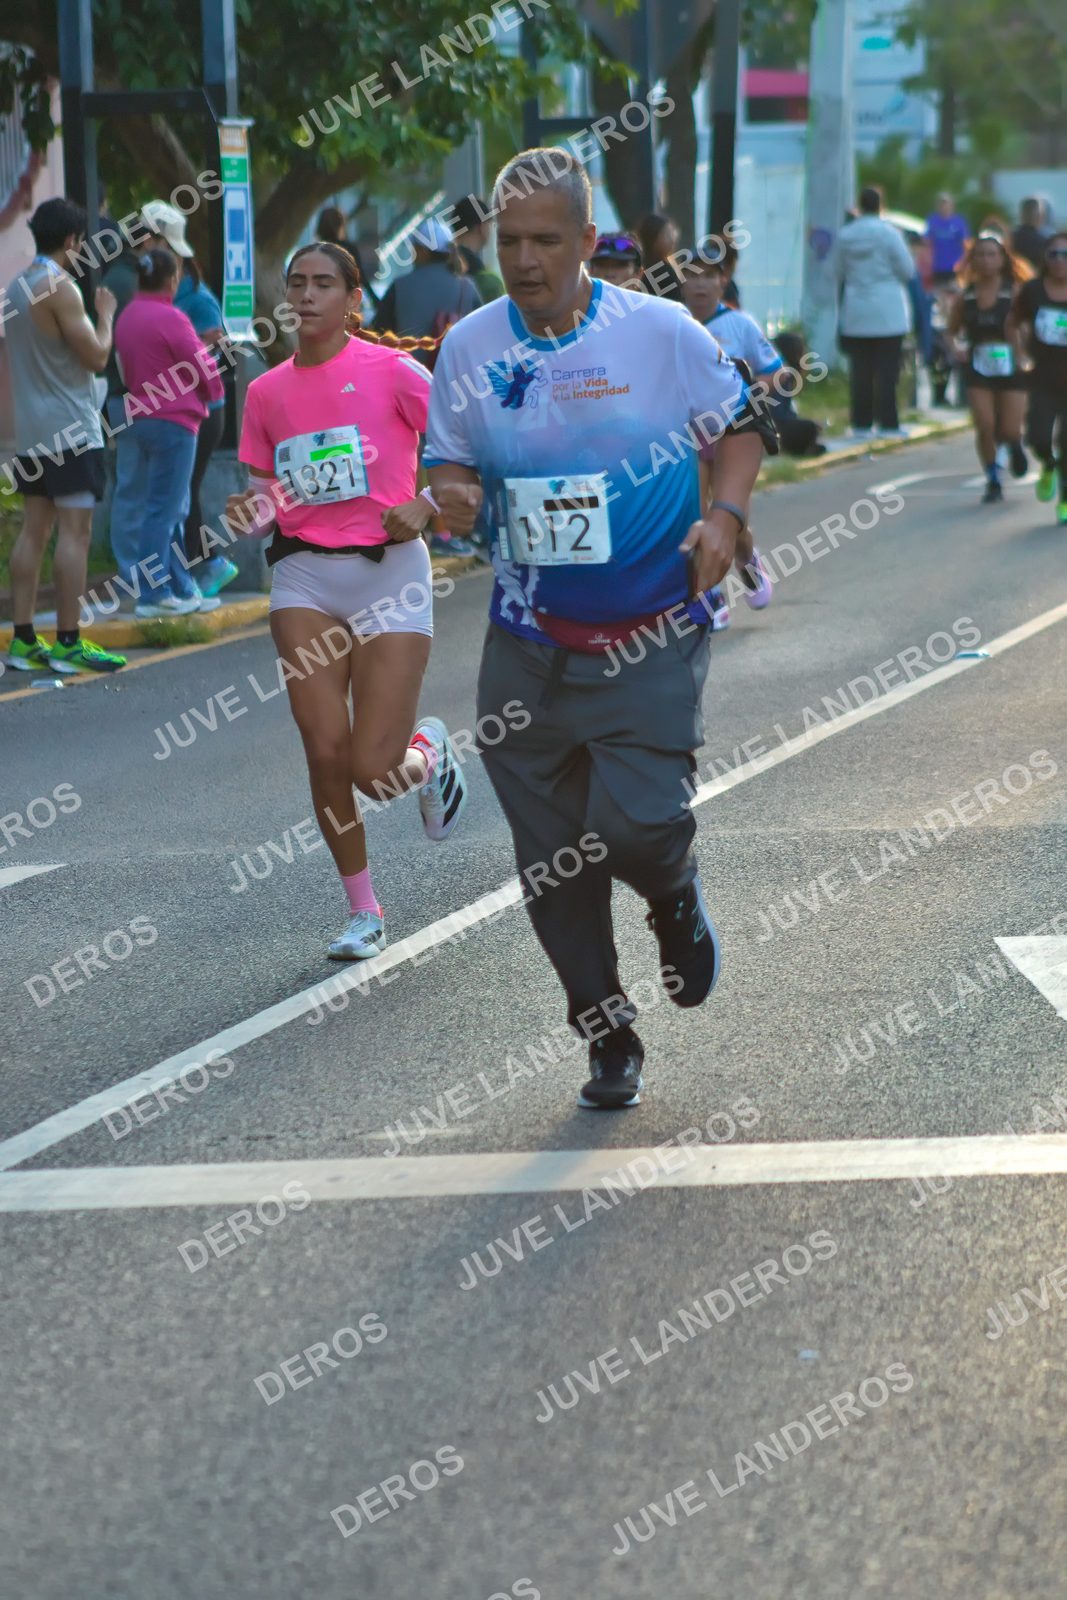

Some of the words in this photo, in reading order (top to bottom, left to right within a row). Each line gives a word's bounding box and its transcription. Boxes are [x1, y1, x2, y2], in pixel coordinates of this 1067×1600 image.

[551, 366, 606, 381] Carrera
[552, 382, 569, 393] por
[572, 379, 582, 389] la
[583, 377, 608, 387] Vida
[560, 390, 570, 400] la
[573, 384, 629, 400] Integridad
[283, 457, 355, 497] 1321
[518, 513, 592, 553] 112
